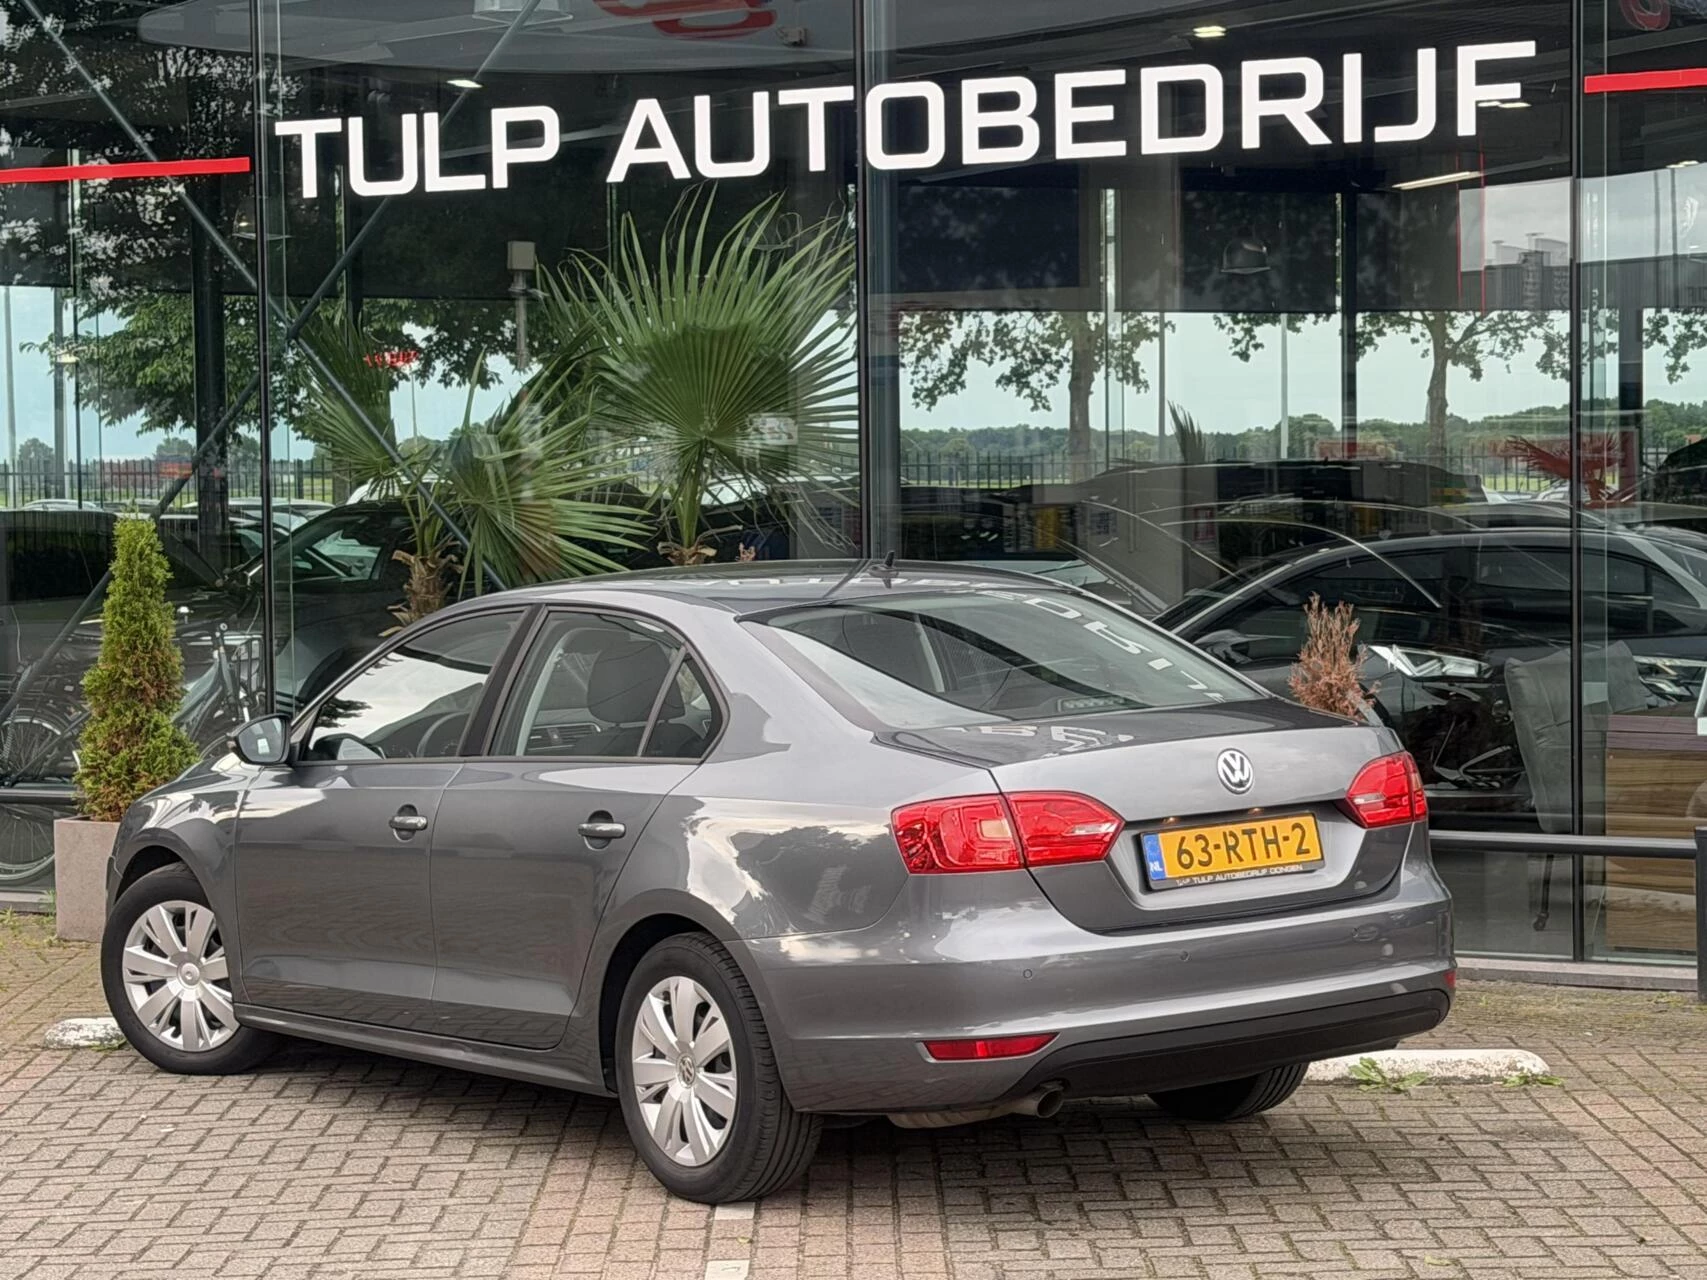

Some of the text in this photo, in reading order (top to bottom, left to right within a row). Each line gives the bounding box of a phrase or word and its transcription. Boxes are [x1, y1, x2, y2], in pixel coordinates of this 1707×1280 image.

[275, 40, 1536, 199] TULP AUTOBEDRIJF
[1177, 822, 1310, 869] 63-RTH-2
[1150, 862, 1163, 872] NL
[1193, 875, 1214, 885] TULP
